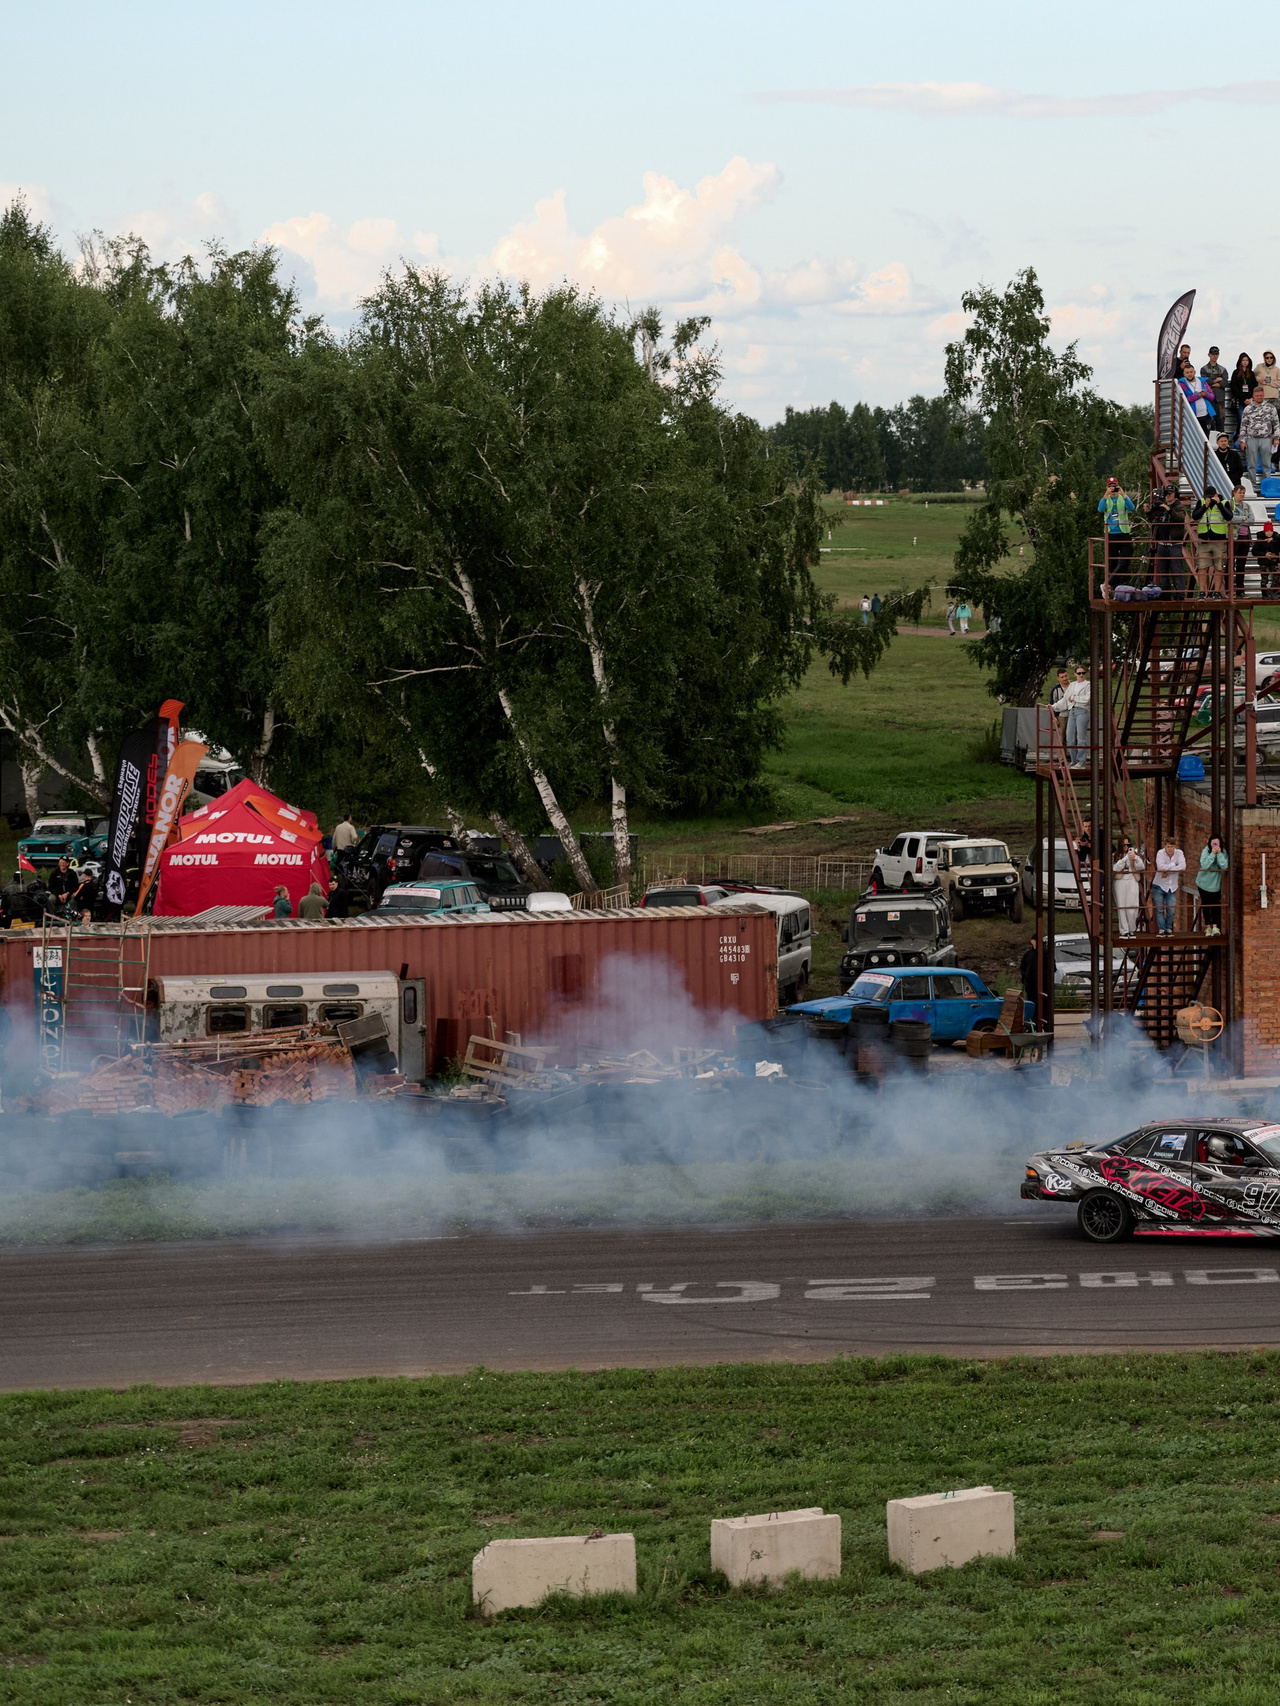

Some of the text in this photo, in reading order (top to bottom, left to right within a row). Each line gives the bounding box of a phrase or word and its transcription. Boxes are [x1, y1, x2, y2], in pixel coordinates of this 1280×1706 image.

[194, 832, 275, 845] MOTUL
[169, 854, 219, 866] MOTUL
[253, 853, 303, 866] MOTUL
[719, 936, 737, 944] CRXU
